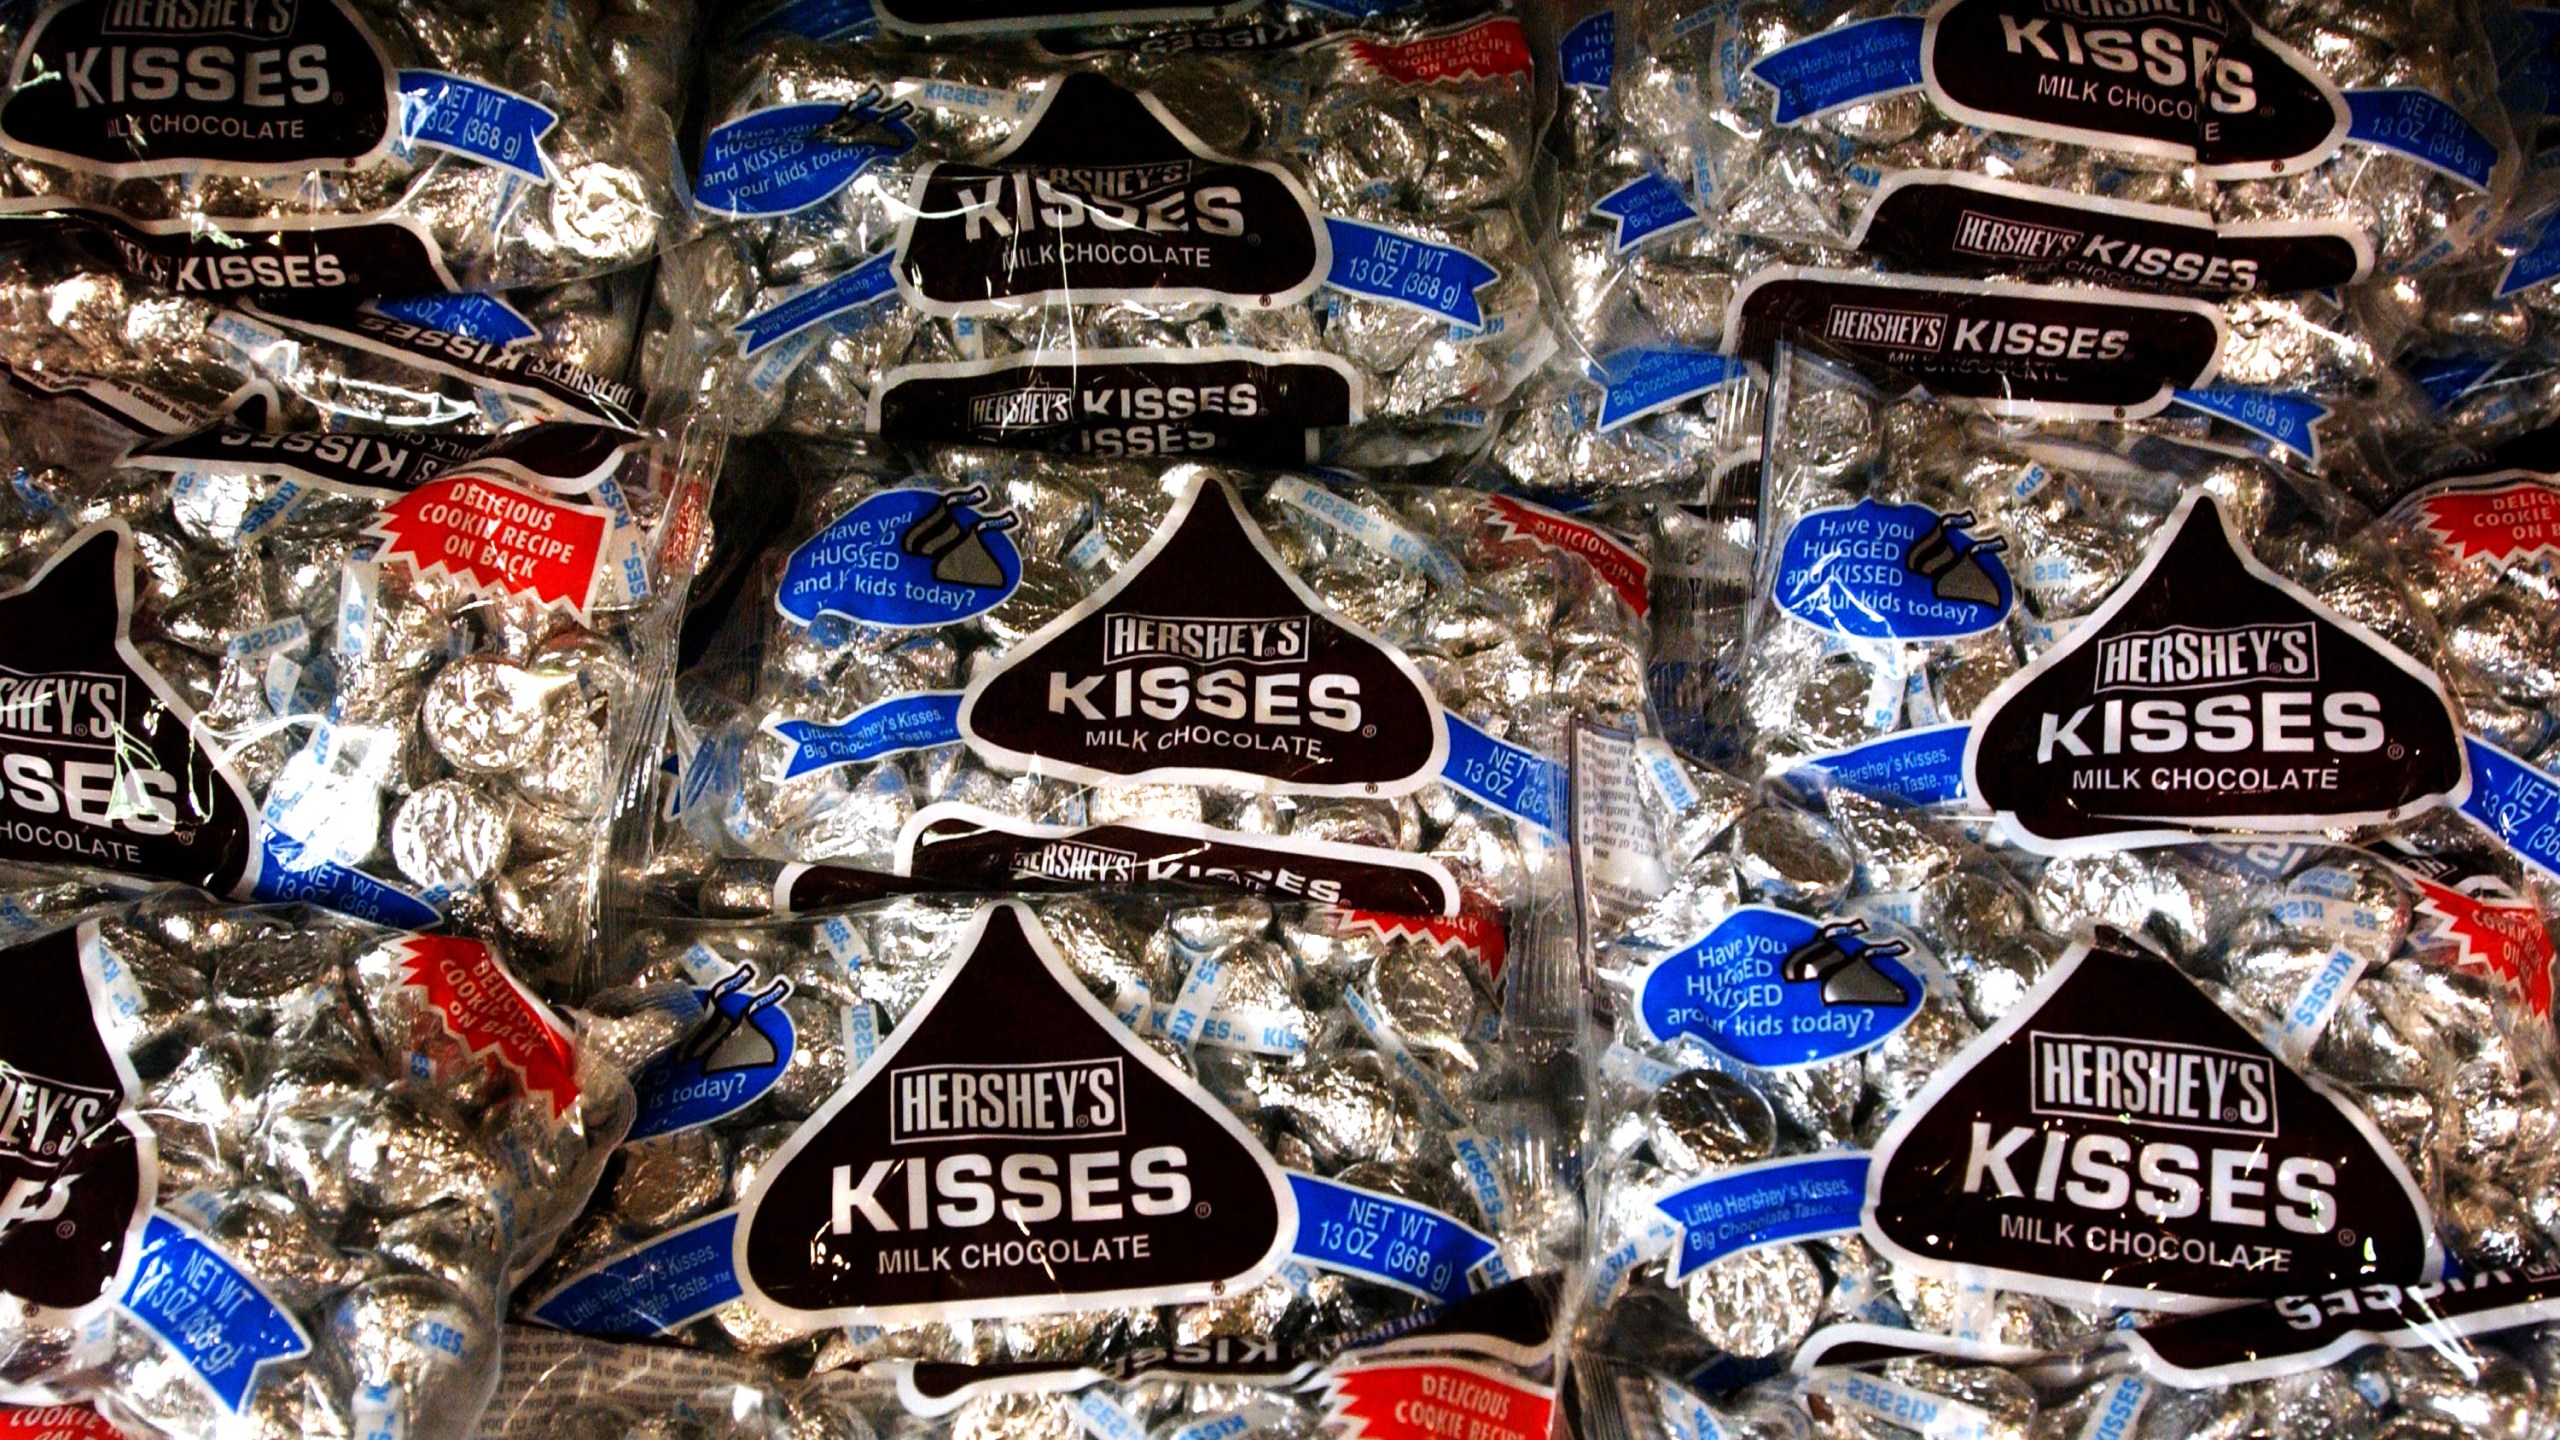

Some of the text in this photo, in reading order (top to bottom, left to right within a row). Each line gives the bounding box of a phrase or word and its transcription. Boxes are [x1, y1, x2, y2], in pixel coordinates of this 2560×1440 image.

[66, 45, 331, 109] KISSES
[1417, 59, 1441, 77] ON
[1801, 45, 1863, 78] Hershey's
[1799, 69, 1861, 103] Chocolate
[2037, 74, 2099, 102] MILK
[476, 92, 507, 122] WT
[2399, 95, 2436, 121] NET
[150, 113, 305, 140] CHOCOLATE
[437, 113, 523, 161] OZ (368 g)
[2371, 117, 2392, 134] 13
[2395, 117, 2424, 145] OZ
[703, 141, 804, 187] and KISSED
[727, 176, 769, 201] your
[776, 159, 808, 188] kids
[1001, 242, 1211, 272] MILK CHOCOLATE
[1372, 235, 1449, 272] NET WT
[1960, 215, 2077, 258] HERSHEY'S
[2082, 233, 2260, 293] KISSES
[175, 253, 347, 292] KISSES
[1349, 256, 1462, 311] 13 OZ (368 g)
[1831, 308, 2130, 360] HERSHEY'S KISSES
[1083, 383, 1259, 421] KISSES
[1611, 387, 1635, 408] Big
[1633, 365, 1691, 398] Chocolate
[2241, 401, 2277, 426] (368
[2274, 415, 2296, 438] g)
[451, 480, 556, 532] DELICIOUS
[2473, 506, 2552, 527] COOKIE
[501, 522, 576, 566] RECIPE
[823, 511, 914, 544] Have you
[1819, 518, 1915, 542] Have you
[2512, 525, 2543, 540] ON
[444, 533, 475, 562] ON
[1803, 539, 1899, 561] HUGGED
[793, 570, 832, 595] and
[854, 577, 976, 611] kids today?
[1830, 564, 1903, 588] KISSED
[1860, 590, 1901, 613] kids
[1908, 602, 1979, 627] today?
[1113, 617, 1301, 659] HERSHEY'S
[2104, 629, 2309, 684] HERSHEY'S
[1049, 665, 1363, 733] KISSES
[898, 707, 946, 729] Kisses.
[2037, 691, 2385, 765] KISSES
[803, 743, 827, 760] Big
[1085, 724, 1323, 761] MILK CHOCOLATE
[1488, 745, 1531, 776] NET
[1464, 758, 1515, 799] 13 OZ
[1837, 747, 1951, 784] Hershey's Kisses.
[1900, 773, 1941, 795] Taste.
[2072, 767, 2339, 790] MILK CHOCOLATE
[2507, 772, 2558, 814] NET
[2498, 801, 2533, 837] OZ
[274, 875, 297, 897] 13
[350, 875, 385, 902] WT
[1697, 933, 1788, 969] Have you
[2296, 949, 2357, 1029] KISSES
[448, 1001, 476, 1030] ON
[1735, 1008, 1876, 1040] kids today?
[671, 1072, 747, 1103] today?
[901, 1065, 1116, 1133] HERSHEY'S
[2042, 1041, 2269, 1125] HERSHEY'S
[831, 1144, 1193, 1236] KISSES
[1962, 1121, 2338, 1236] KISSES
[1347, 1197, 1439, 1247] NET WT
[1684, 1200, 1725, 1228] Little
[1724, 1184, 1801, 1218] Hershey's
[1689, 1229, 1717, 1252] Big
[1718, 1206, 1792, 1241] Chocolate
[2000, 1213, 2294, 1273] MILK CHOCOLATE
[665, 1241, 720, 1276] Kisses.
[877, 1233, 1152, 1276] MILK CHOCOLATE
[1318, 1219, 1454, 1294] 13 OZ (368 g)
[179, 1247, 255, 1319] NET WT
[667, 1273, 713, 1303] Taste.
[1421, 1373, 1512, 1422] DELICIOUS
[1394, 1399, 1466, 1440] COOKIE
